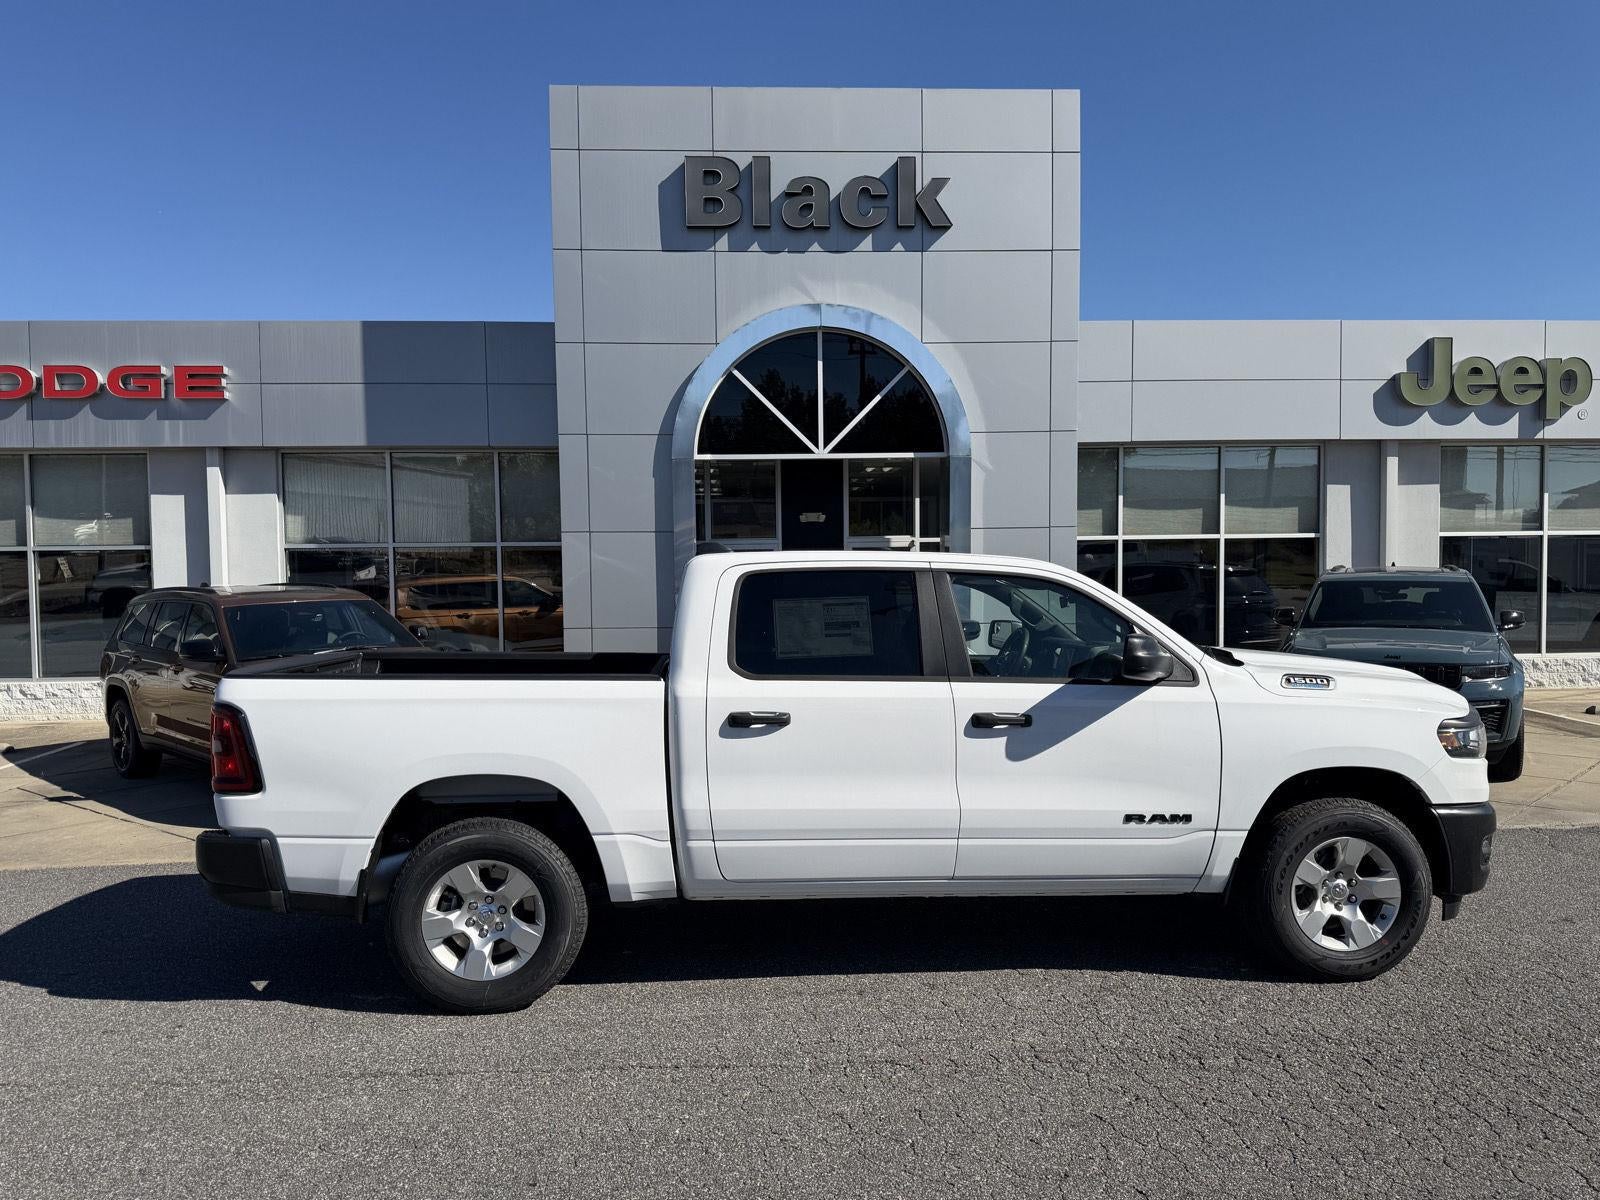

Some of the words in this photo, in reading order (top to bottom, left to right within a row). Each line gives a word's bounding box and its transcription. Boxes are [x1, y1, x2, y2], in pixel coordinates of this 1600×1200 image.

[684, 155, 953, 229] Black
[1399, 336, 1593, 420] Jeep
[1289, 677, 1328, 686] 1500
[1122, 814, 1192, 825] RAM
